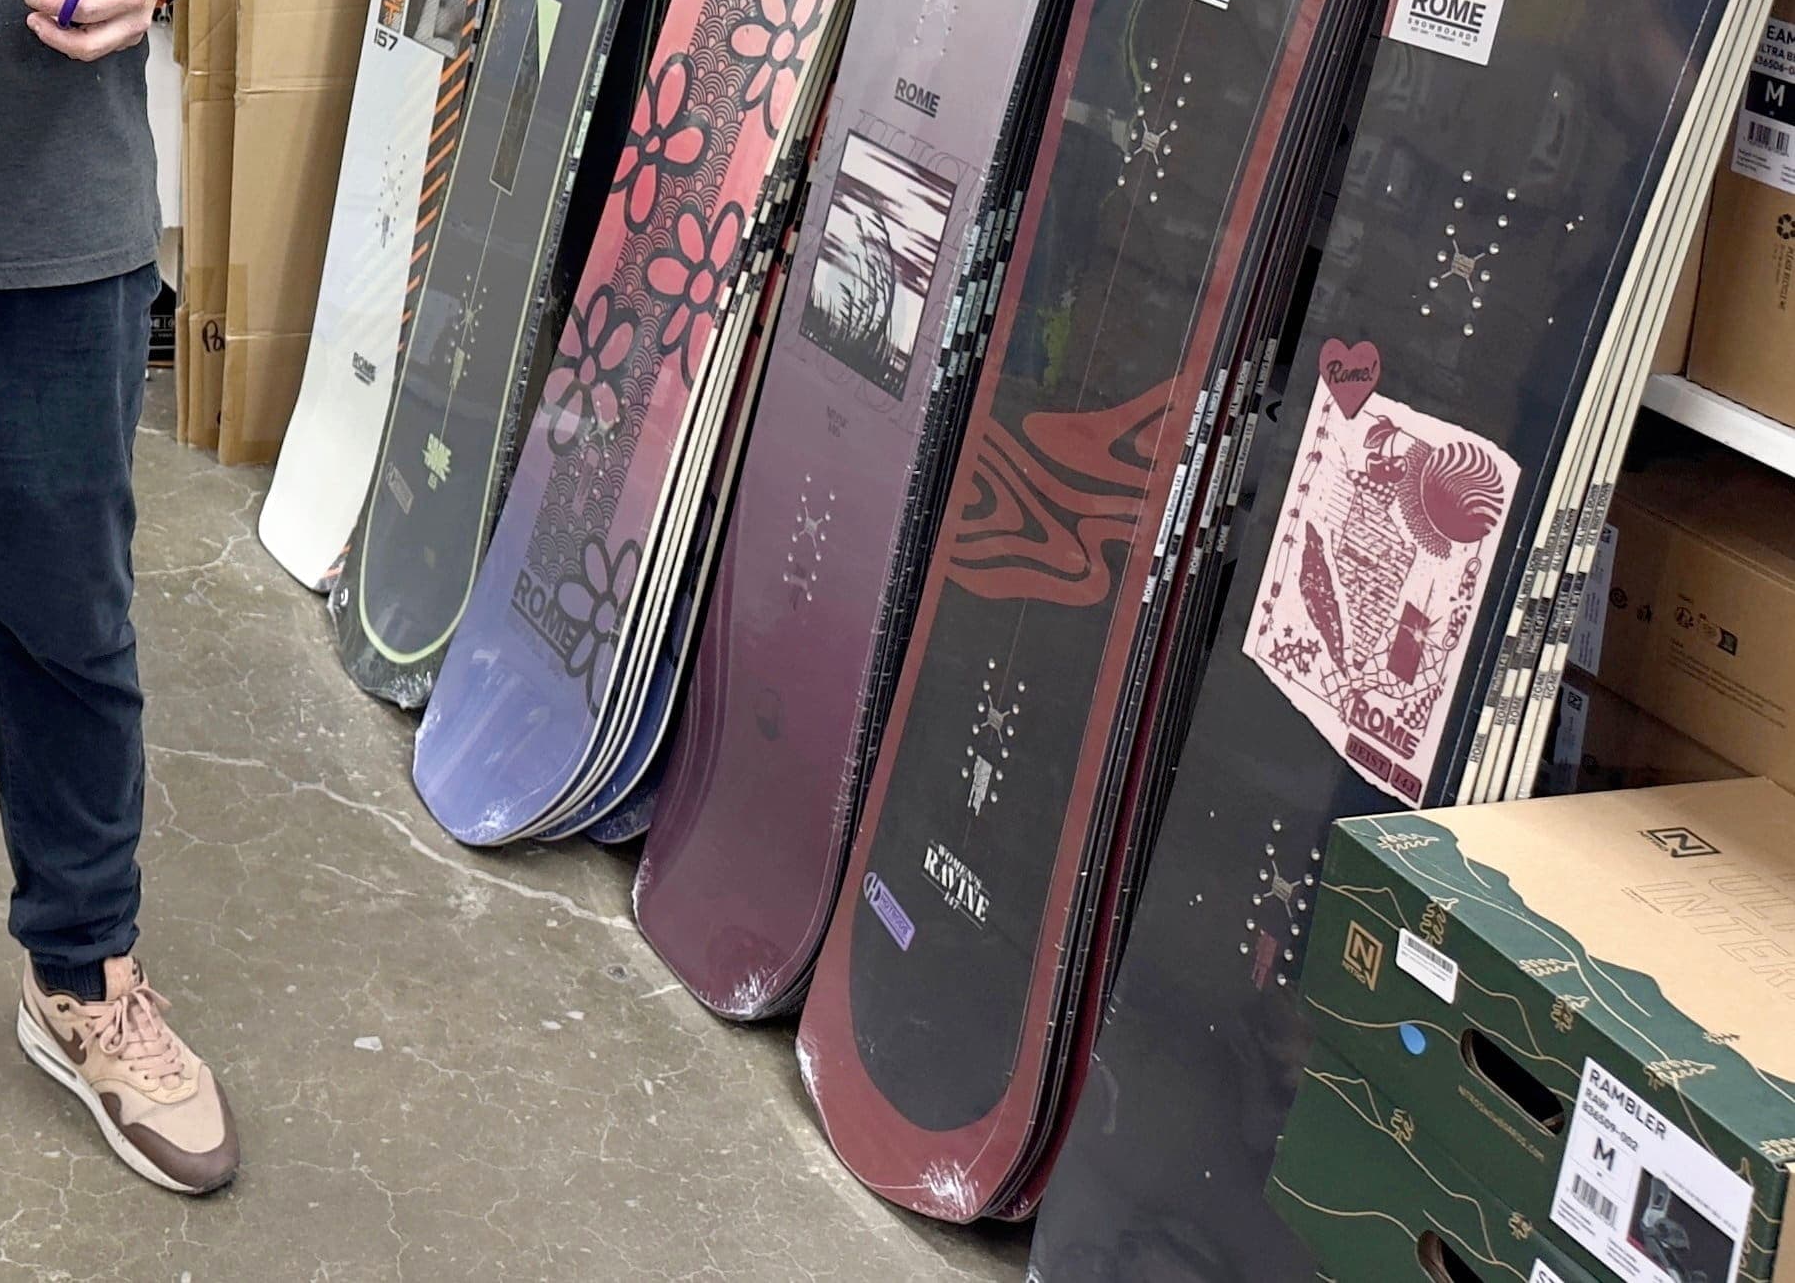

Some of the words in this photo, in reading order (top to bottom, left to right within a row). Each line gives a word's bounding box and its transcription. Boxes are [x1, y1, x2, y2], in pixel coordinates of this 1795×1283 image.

[373, 28, 399, 51] 157
[1407, 18, 1478, 43] SNOWBOARDS
[895, 78, 940, 113] ROME
[1765, 80, 1785, 107] M
[352, 351, 376, 383] ROME
[1327, 359, 1378, 386] Rome!
[513, 570, 576, 651] ROME
[1350, 696, 1420, 754] ROME
[924, 846, 990, 921] RAVINE
[1589, 1069, 1667, 1141] RAMBLER
[1594, 1137, 1615, 1171] M
